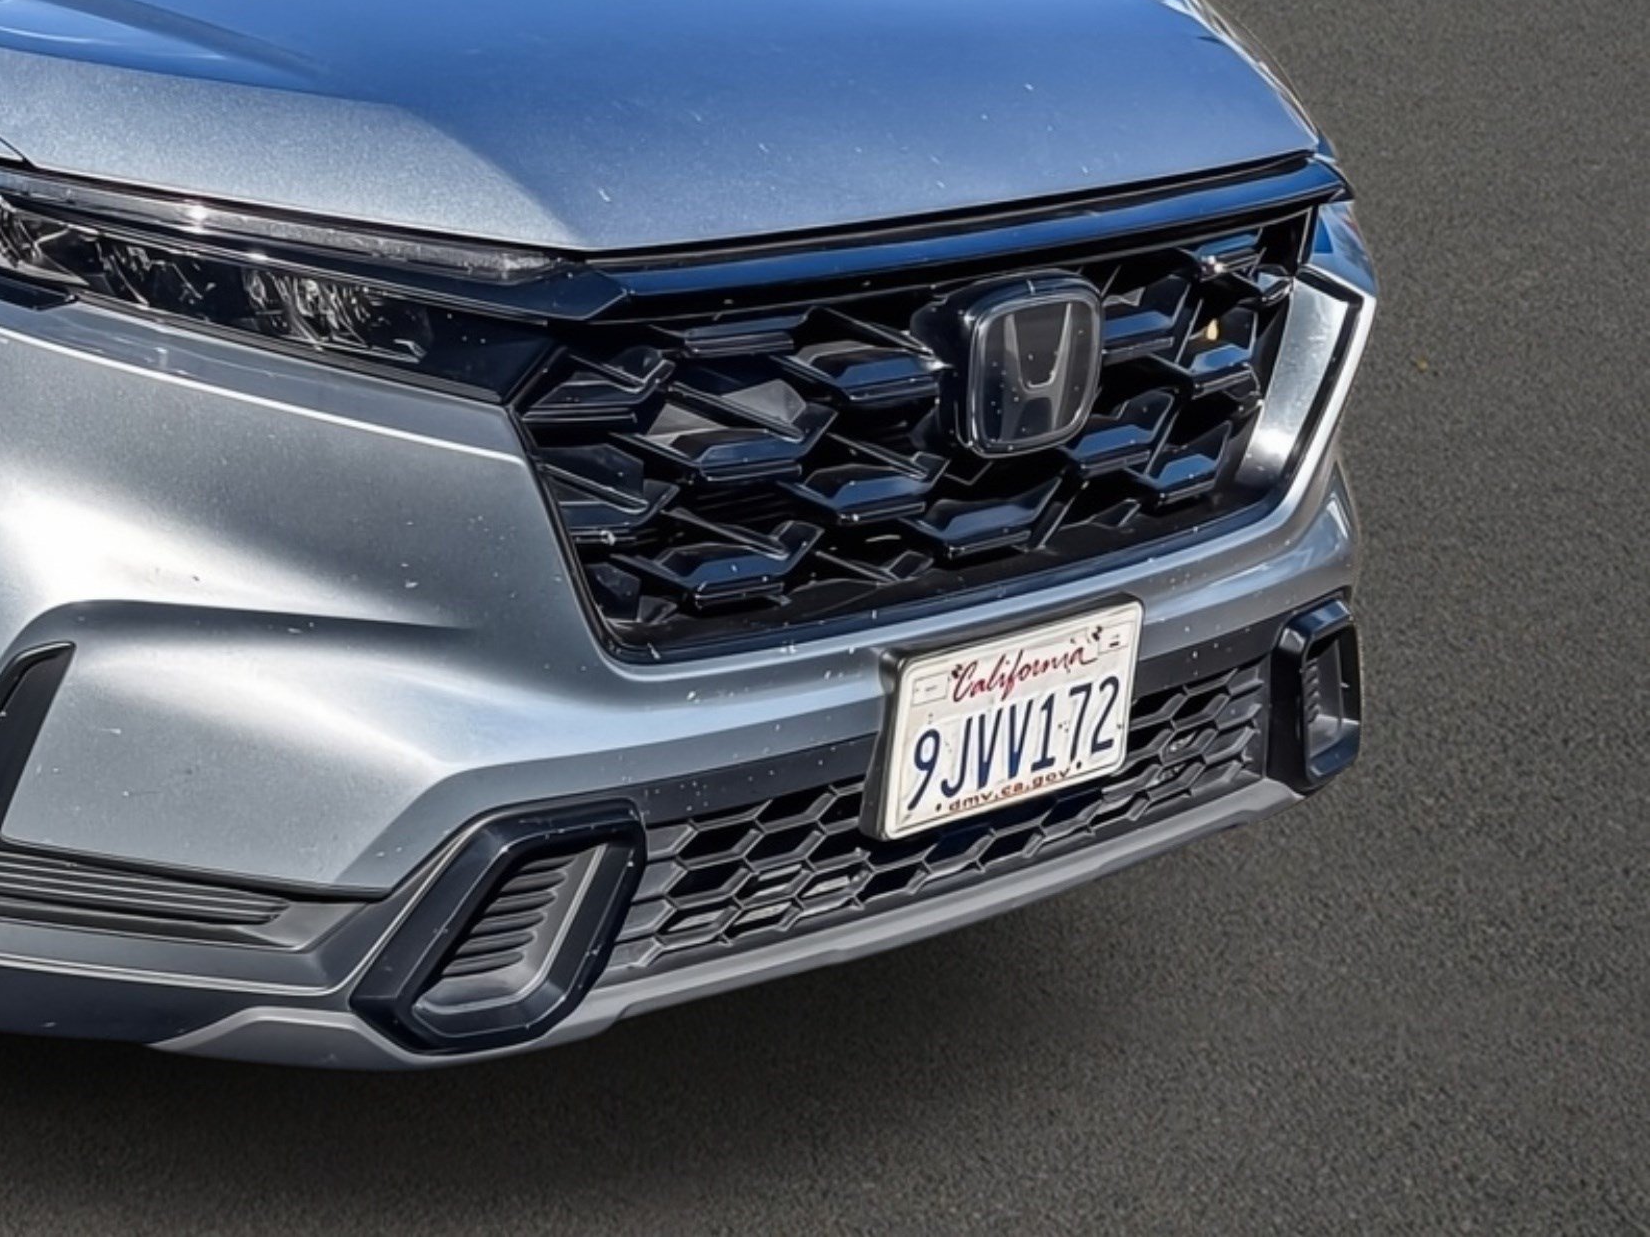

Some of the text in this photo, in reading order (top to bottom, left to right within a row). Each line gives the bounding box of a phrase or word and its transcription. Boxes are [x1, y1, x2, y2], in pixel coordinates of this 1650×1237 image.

[952, 647, 1098, 703] California
[907, 675, 1120, 811] 9JVV172
[948, 766, 1071, 812] dmv.ca.gov
